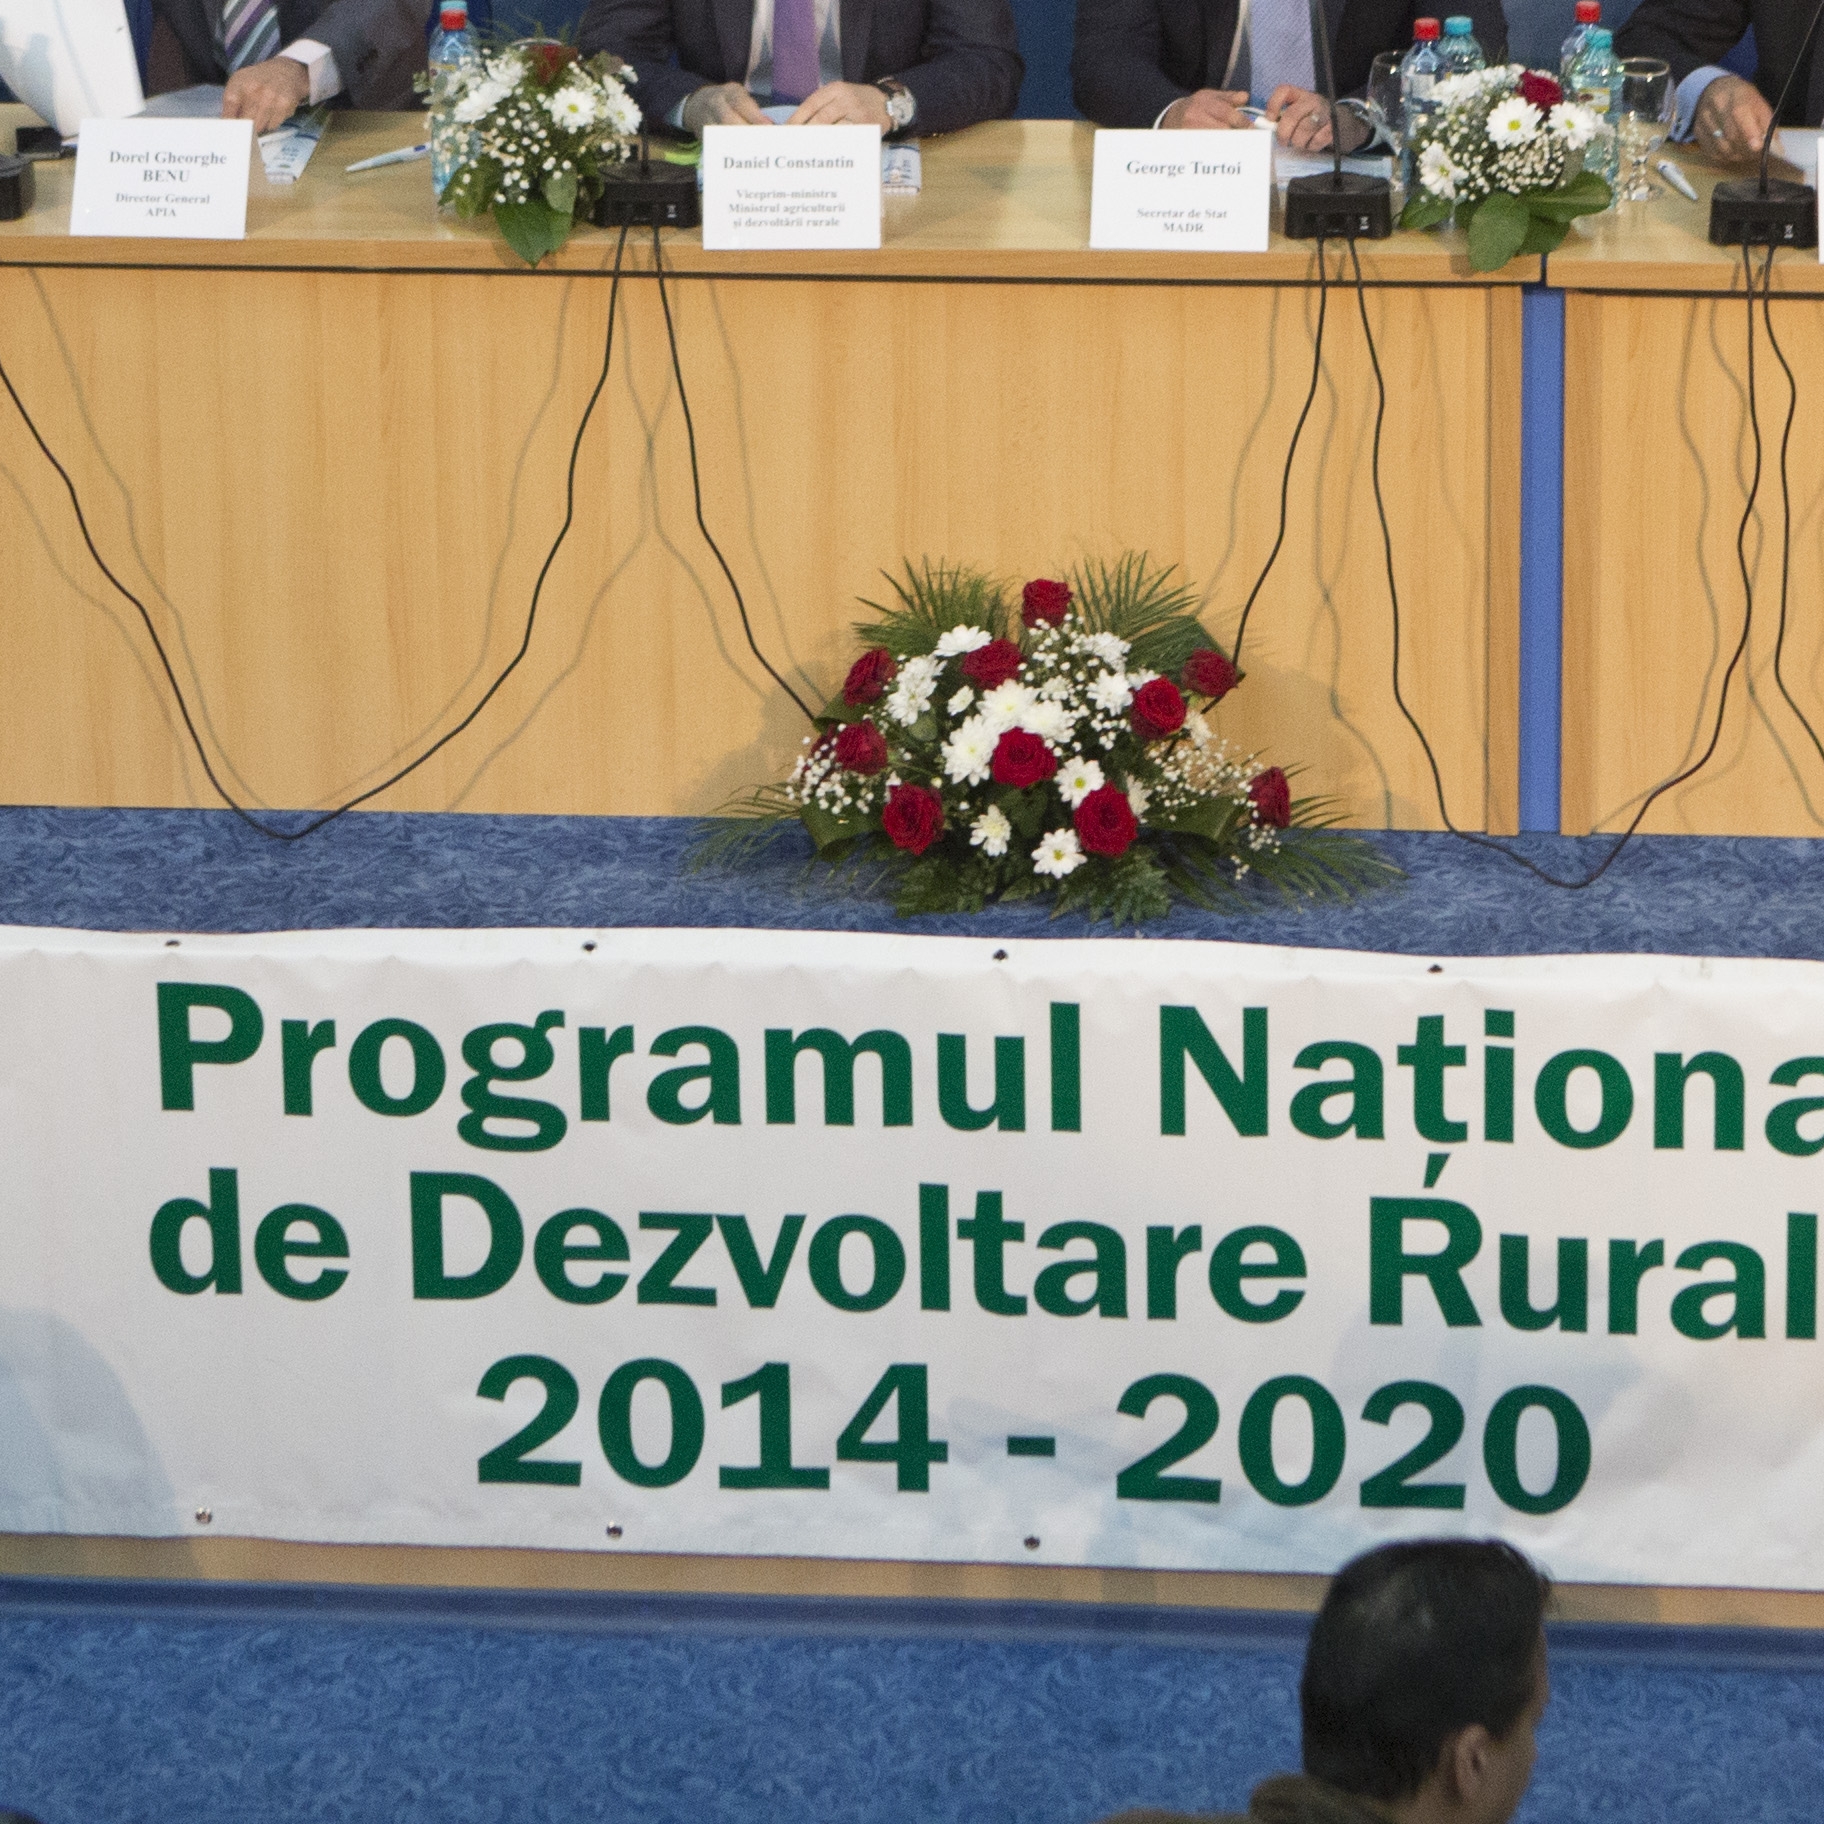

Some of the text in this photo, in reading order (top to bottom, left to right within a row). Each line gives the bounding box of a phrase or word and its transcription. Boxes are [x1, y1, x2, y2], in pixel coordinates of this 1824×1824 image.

[109, 150, 227, 167] Dorel Gheorghe
[723, 155, 854, 169] Daniel Constantin
[1125, 159, 1242, 176] George Turtoi
[143, 169, 190, 182] BENU
[115, 192, 211, 204] Director General
[736, 189, 838, 201] Viceprim-ministru
[145, 206, 177, 217] APIA
[728, 202, 780, 213] Ministrul
[1136, 207, 1228, 219] Secretar de Stat
[806, 217, 841, 227] rurale
[1163, 222, 1205, 233] MADR
[156, 981, 1081, 1153] Programul
[148, 1167, 351, 1302] de
[409, 1169, 1308, 1325] Dezvoltare
[476, 1353, 1592, 1516] 2014 - 2020
